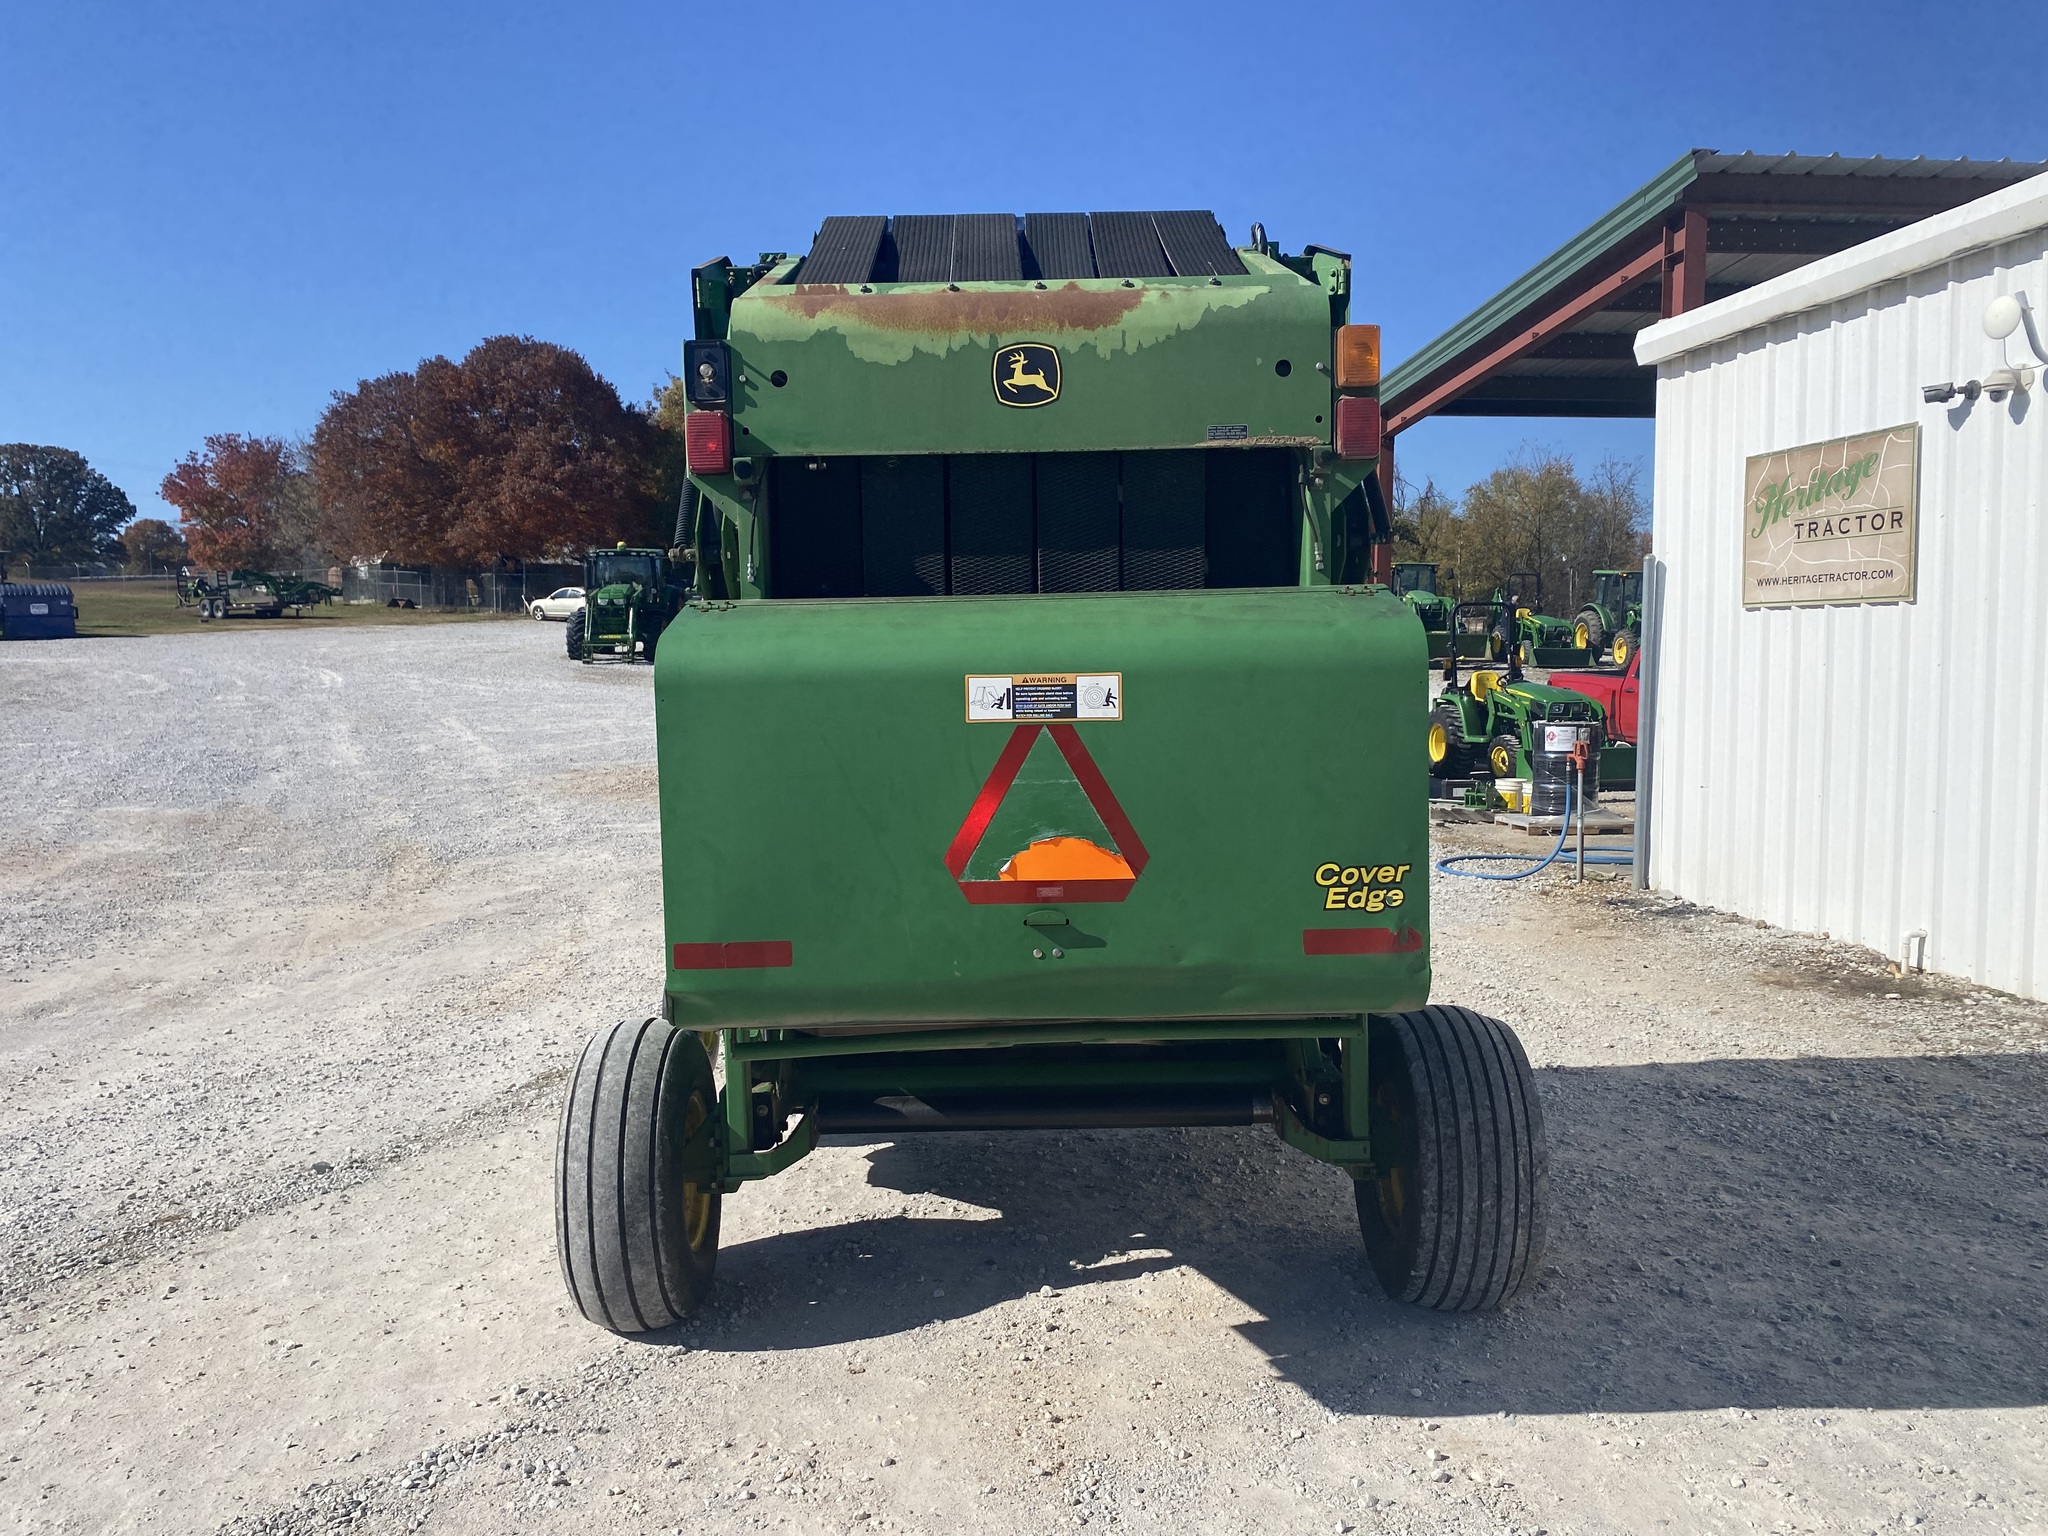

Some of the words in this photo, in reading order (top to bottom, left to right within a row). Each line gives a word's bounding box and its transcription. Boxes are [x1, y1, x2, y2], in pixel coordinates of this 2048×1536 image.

[1751, 451, 1879, 539] Heritage
[1794, 511, 1903, 539] TRACTOR
[1756, 569, 1894, 587] WWW.HERITAGETRACTOR.COM
[1315, 862, 1411, 886] Cover
[1324, 885, 1404, 912] Edge
